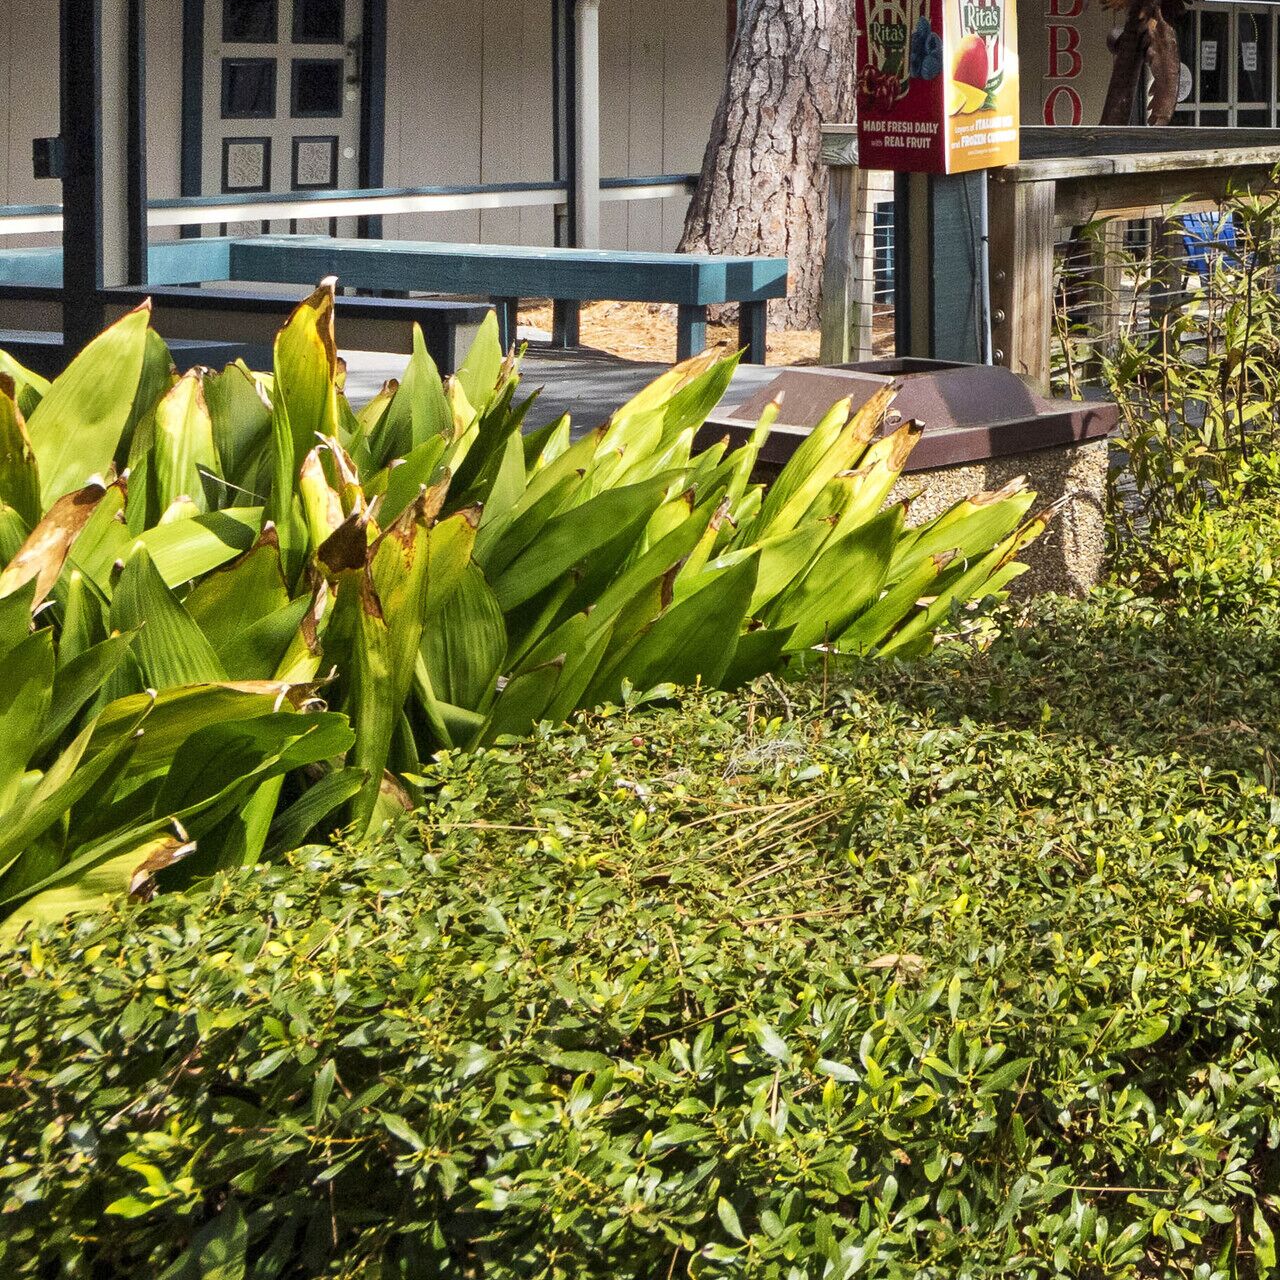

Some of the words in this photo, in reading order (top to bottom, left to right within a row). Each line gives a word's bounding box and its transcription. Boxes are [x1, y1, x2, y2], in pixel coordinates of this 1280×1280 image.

[967, 2, 998, 28] Rita's
[873, 21, 905, 43] Rita's
[863, 120, 886, 132] MADE
[887, 121, 913, 133] FRESH
[914, 122, 939, 134] DAILY
[884, 136, 905, 147] REAL
[906, 137, 931, 148] FRUIT
